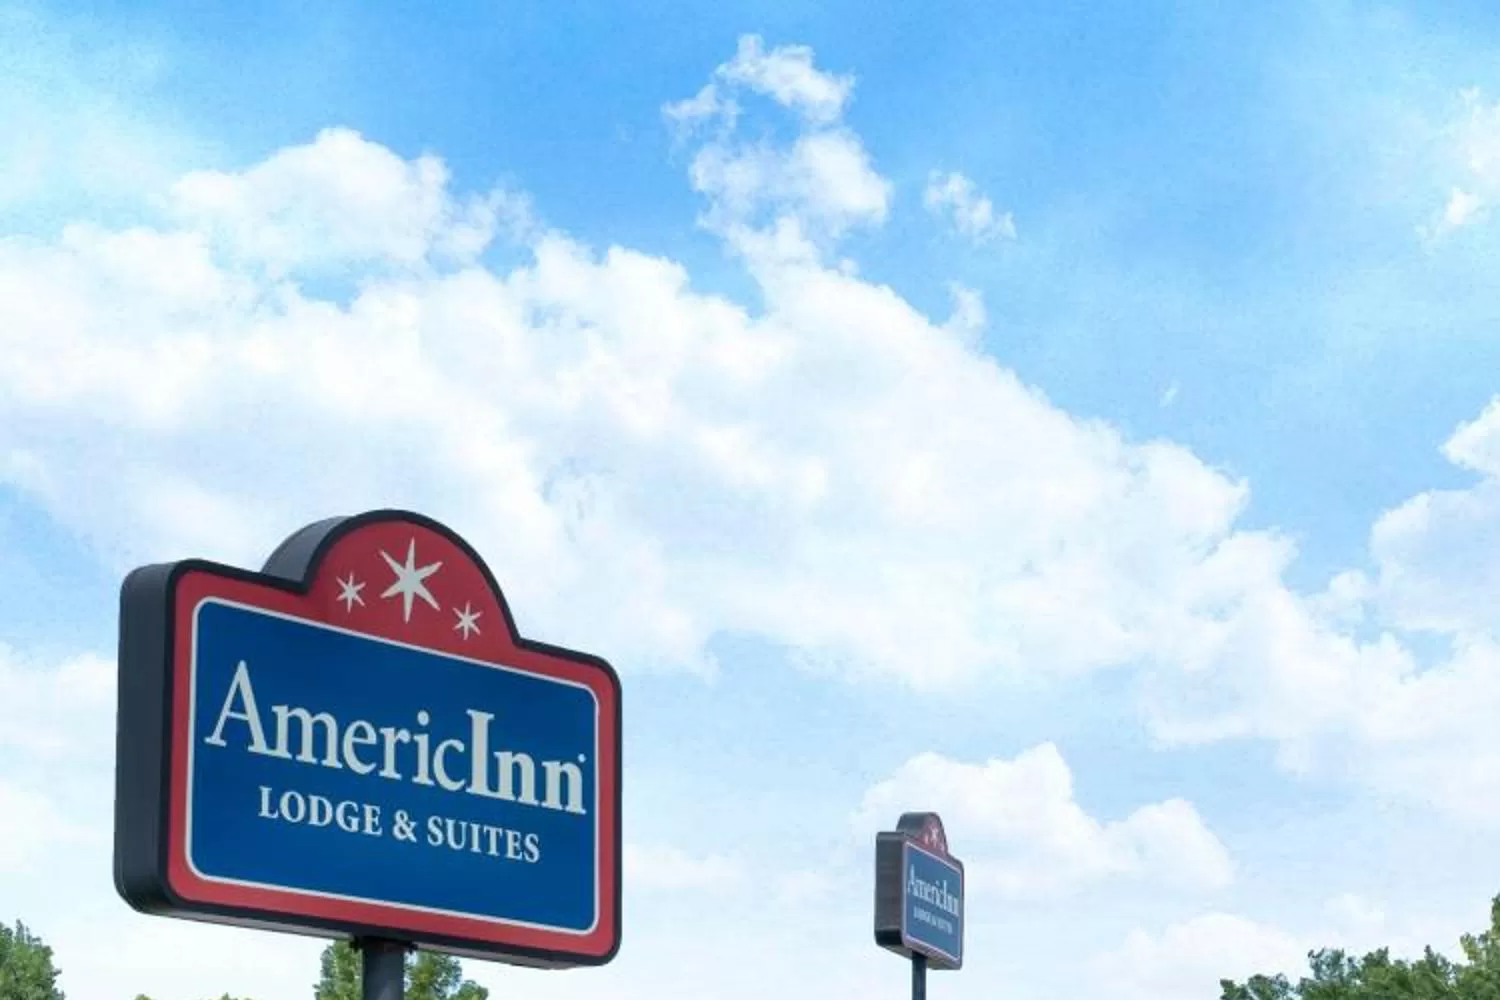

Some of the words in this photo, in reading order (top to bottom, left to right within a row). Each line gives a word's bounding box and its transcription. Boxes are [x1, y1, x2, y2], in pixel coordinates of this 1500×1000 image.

[204, 660, 587, 815] AmericInn
[258, 786, 382, 835] LODGE
[393, 810, 417, 842] &
[427, 816, 540, 863] SUITES
